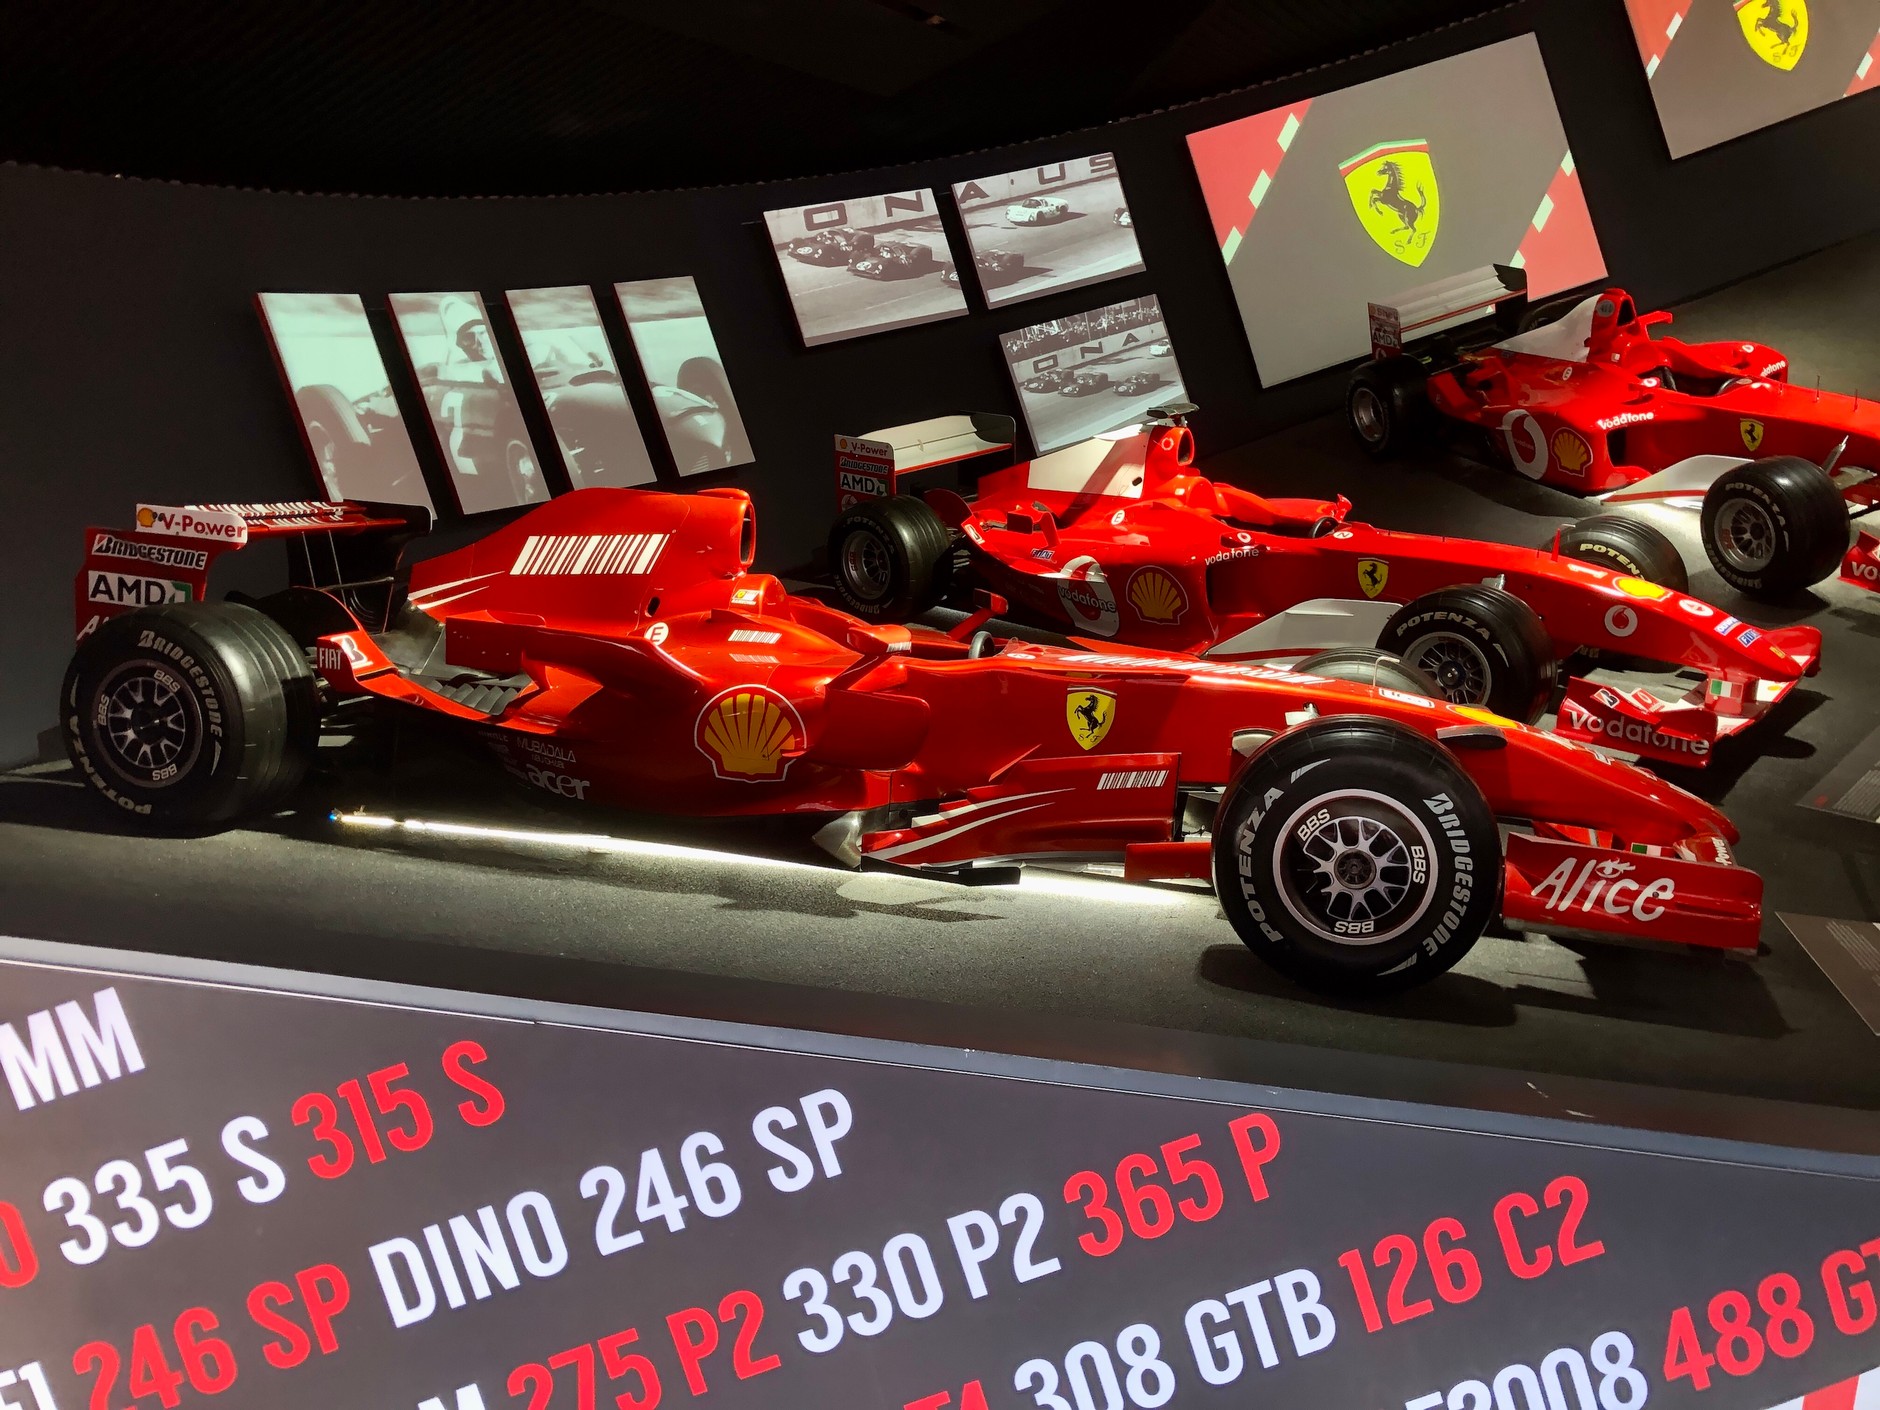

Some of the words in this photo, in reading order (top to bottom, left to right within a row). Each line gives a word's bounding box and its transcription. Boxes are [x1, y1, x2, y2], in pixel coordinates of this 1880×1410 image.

[851, 441, 888, 457] V-Power
[841, 474, 875, 494] AMD
[161, 513, 247, 538] V-Power
[92, 534, 208, 571] BRIDGESTONE
[1204, 547, 1260, 566] vodafone
[1580, 543, 1646, 581] POTEN
[90, 574, 166, 606] AMD
[1058, 587, 1117, 613] vodafone
[1396, 611, 1491, 642] POTENZA
[318, 646, 342, 671] FIAT
[138, 629, 223, 738] BRIDGESTONE
[153, 669, 180, 693] BBS
[98, 694, 110, 726] BBS
[1565, 708, 1710, 755] vodafone
[152, 763, 178, 781] BBS
[526, 763, 590, 800] acer
[1297, 808, 1331, 842] BBS
[1238, 787, 1284, 942] POTENZA
[1410, 845, 1426, 885] BBS
[1422, 792, 1473, 957] BRIDGESTONE
[1531, 857, 1675, 922] Alice
[1334, 920, 1375, 934] BBS
[0, 987, 146, 1111] MM
[43, 1139, 213, 1265] 335
[221, 1115, 286, 1204] S
[291, 1063, 434, 1180] 315
[441, 1040, 506, 1127] S
[72, 1307, 238, 1410] 246
[246, 1263, 351, 1369] SP
[368, 1191, 568, 1329] DINO
[579, 1131, 742, 1256] 246
[752, 1089, 853, 1193] SP
[506, 1327, 662, 1410] 275
[666, 1289, 781, 1396] P2
[783, 1233, 944, 1353] 330
[946, 1193, 1062, 1300] P2
[1063, 1133, 1224, 1257] 365
[1228, 1112, 1281, 1202] P
[1014, 1324, 1176, 1410] 308
[1184, 1269, 1336, 1385] GTB
[1338, 1217, 1483, 1333] 126
[1493, 1175, 1605, 1279] C2
[1404, 1331, 1648, 1410] 008
[1663, 1274, 1815, 1390] 488
